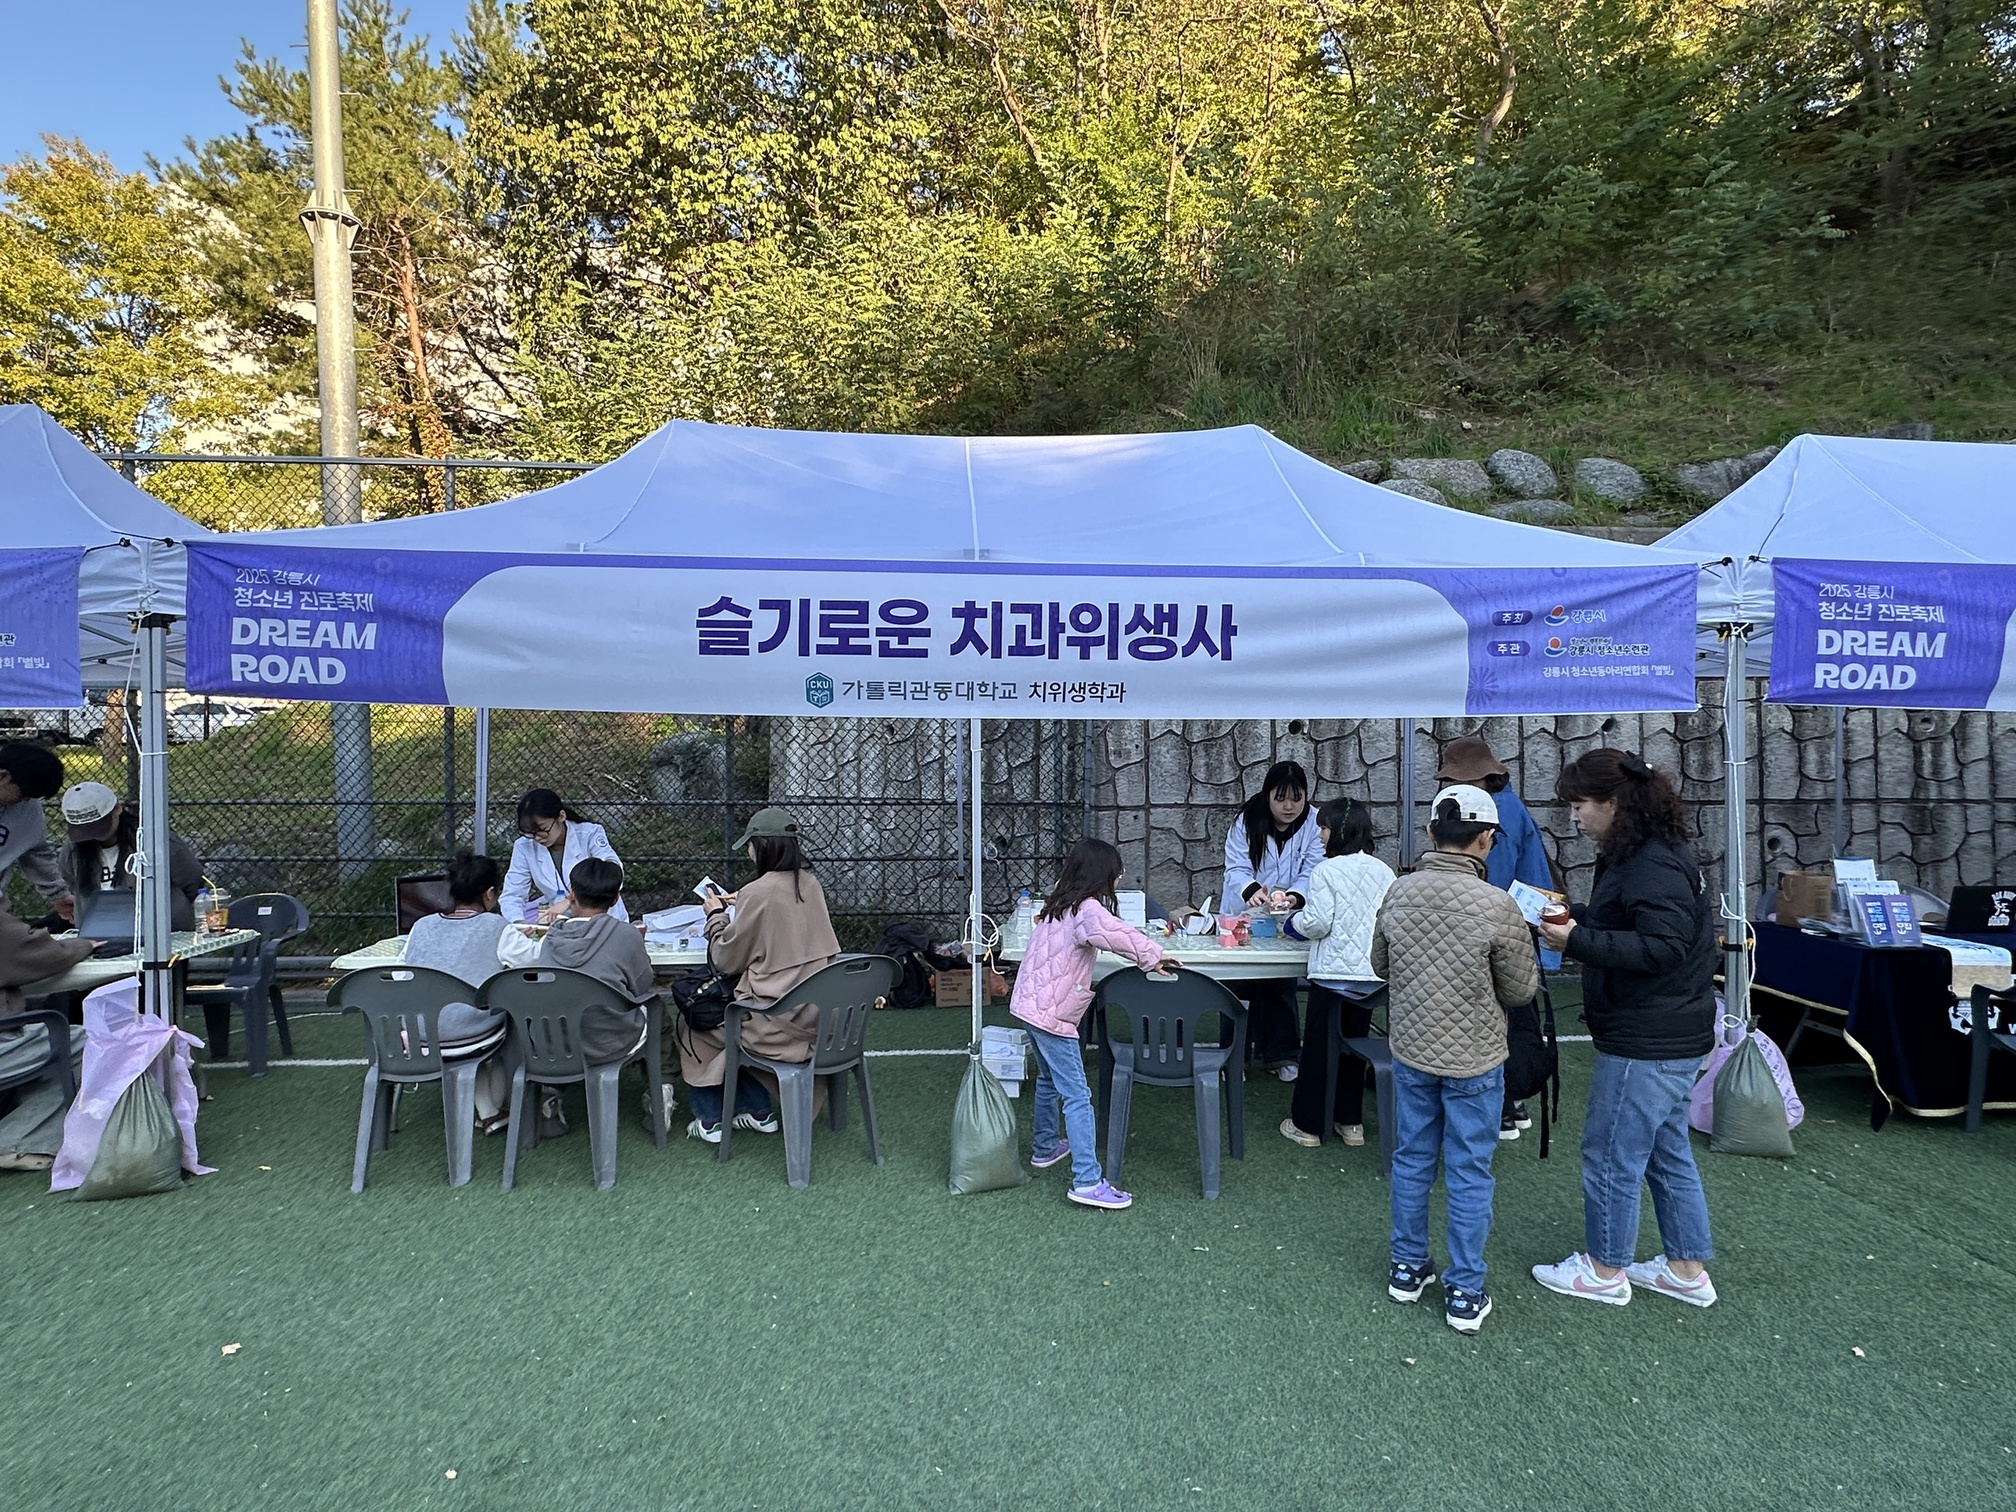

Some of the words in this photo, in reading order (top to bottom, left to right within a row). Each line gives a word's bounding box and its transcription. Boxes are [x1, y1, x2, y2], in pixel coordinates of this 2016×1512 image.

[235, 568, 271, 584] 2025
[272, 569, 321, 586] 강릉시
[234, 587, 294, 609] 청소년
[299, 591, 374, 613] 진로축제
[1819, 582, 1851, 598] 2025
[1853, 584, 1894, 599] 강릉시
[1571, 609, 1607, 625] 강릉시
[1818, 601, 1873, 621] 청소년
[1877, 603, 1946, 624] 진로축제
[231, 616, 377, 650] DREAM
[696, 595, 931, 659] 슬기로운
[950, 600, 1238, 661] 치과위생사
[1569, 644, 1595, 657] 강릉시
[1596, 643, 1650, 658] 청소년수련관
[1817, 629, 1947, 658] DREAM
[231, 653, 347, 685] ROAD
[1542, 666, 1570, 678] 강릉시
[1571, 664, 1649, 678] 청소년동아리연합회
[1814, 662, 1917, 691] ROAD
[810, 680, 829, 689] CKU
[841, 680, 1018, 702] 가톨릭관동대학교
[1028, 681, 1127, 703] 치위생학과
